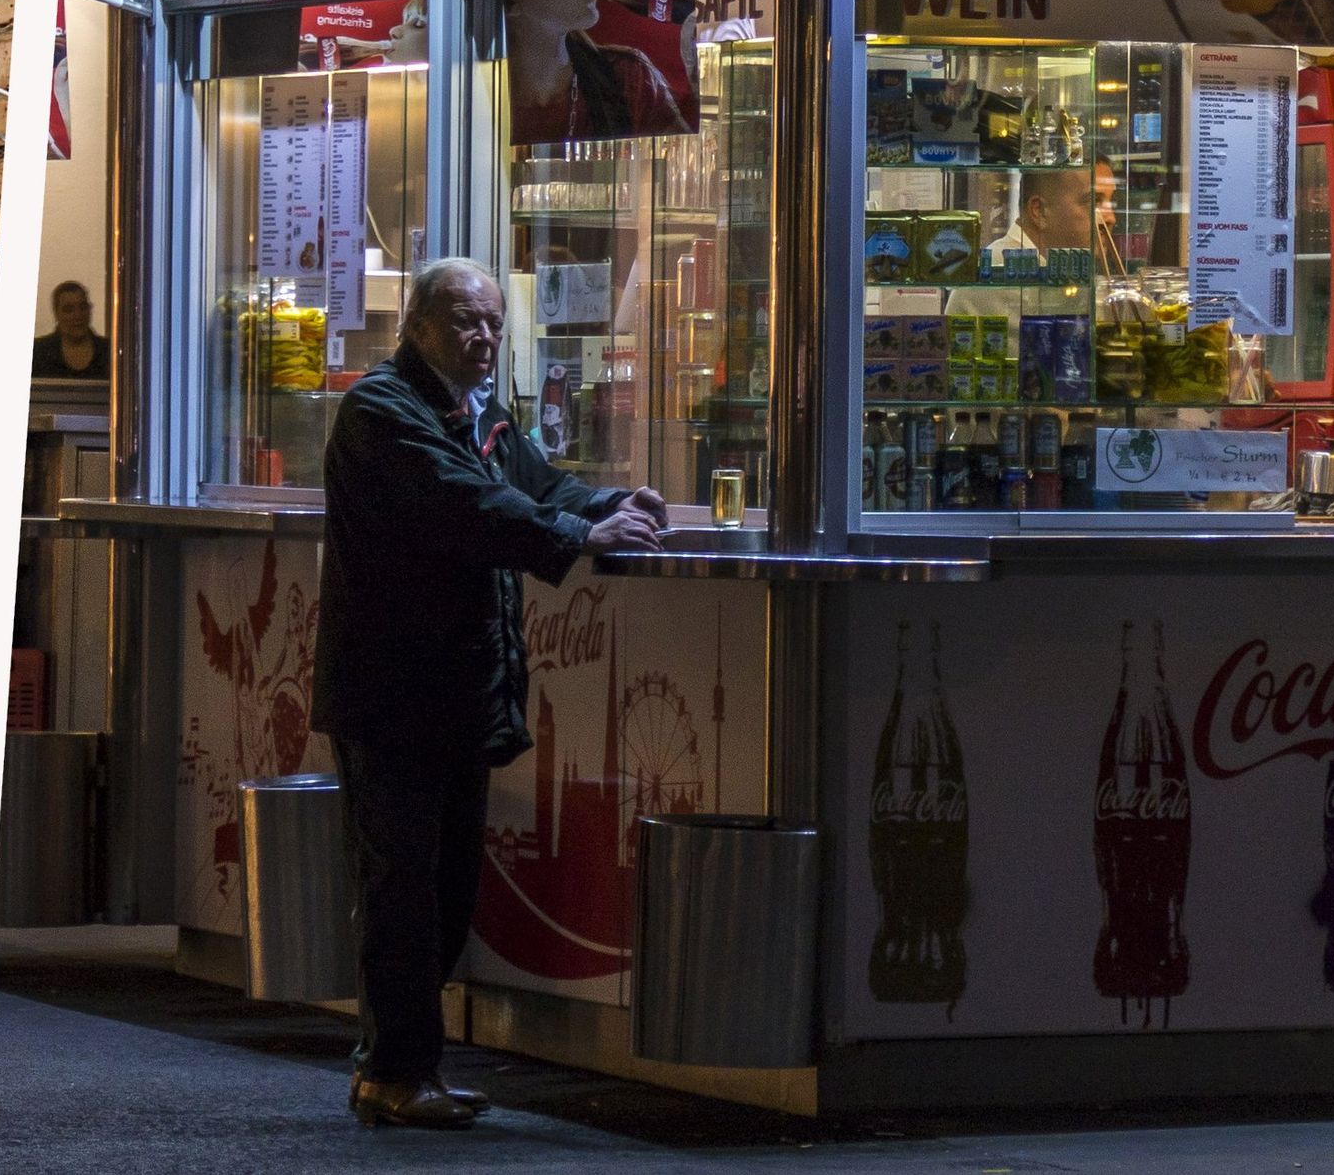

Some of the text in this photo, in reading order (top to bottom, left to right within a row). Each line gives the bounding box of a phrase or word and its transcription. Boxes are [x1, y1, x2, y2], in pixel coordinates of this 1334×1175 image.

[1200, 54, 1238, 62] GETRÄNKE
[922, 146, 957, 157] BOUNTY
[1221, 444, 1279, 470] Sturm
[870, 779, 967, 823] Coca-Cola
[1095, 776, 1190, 821] Coca-Cola
